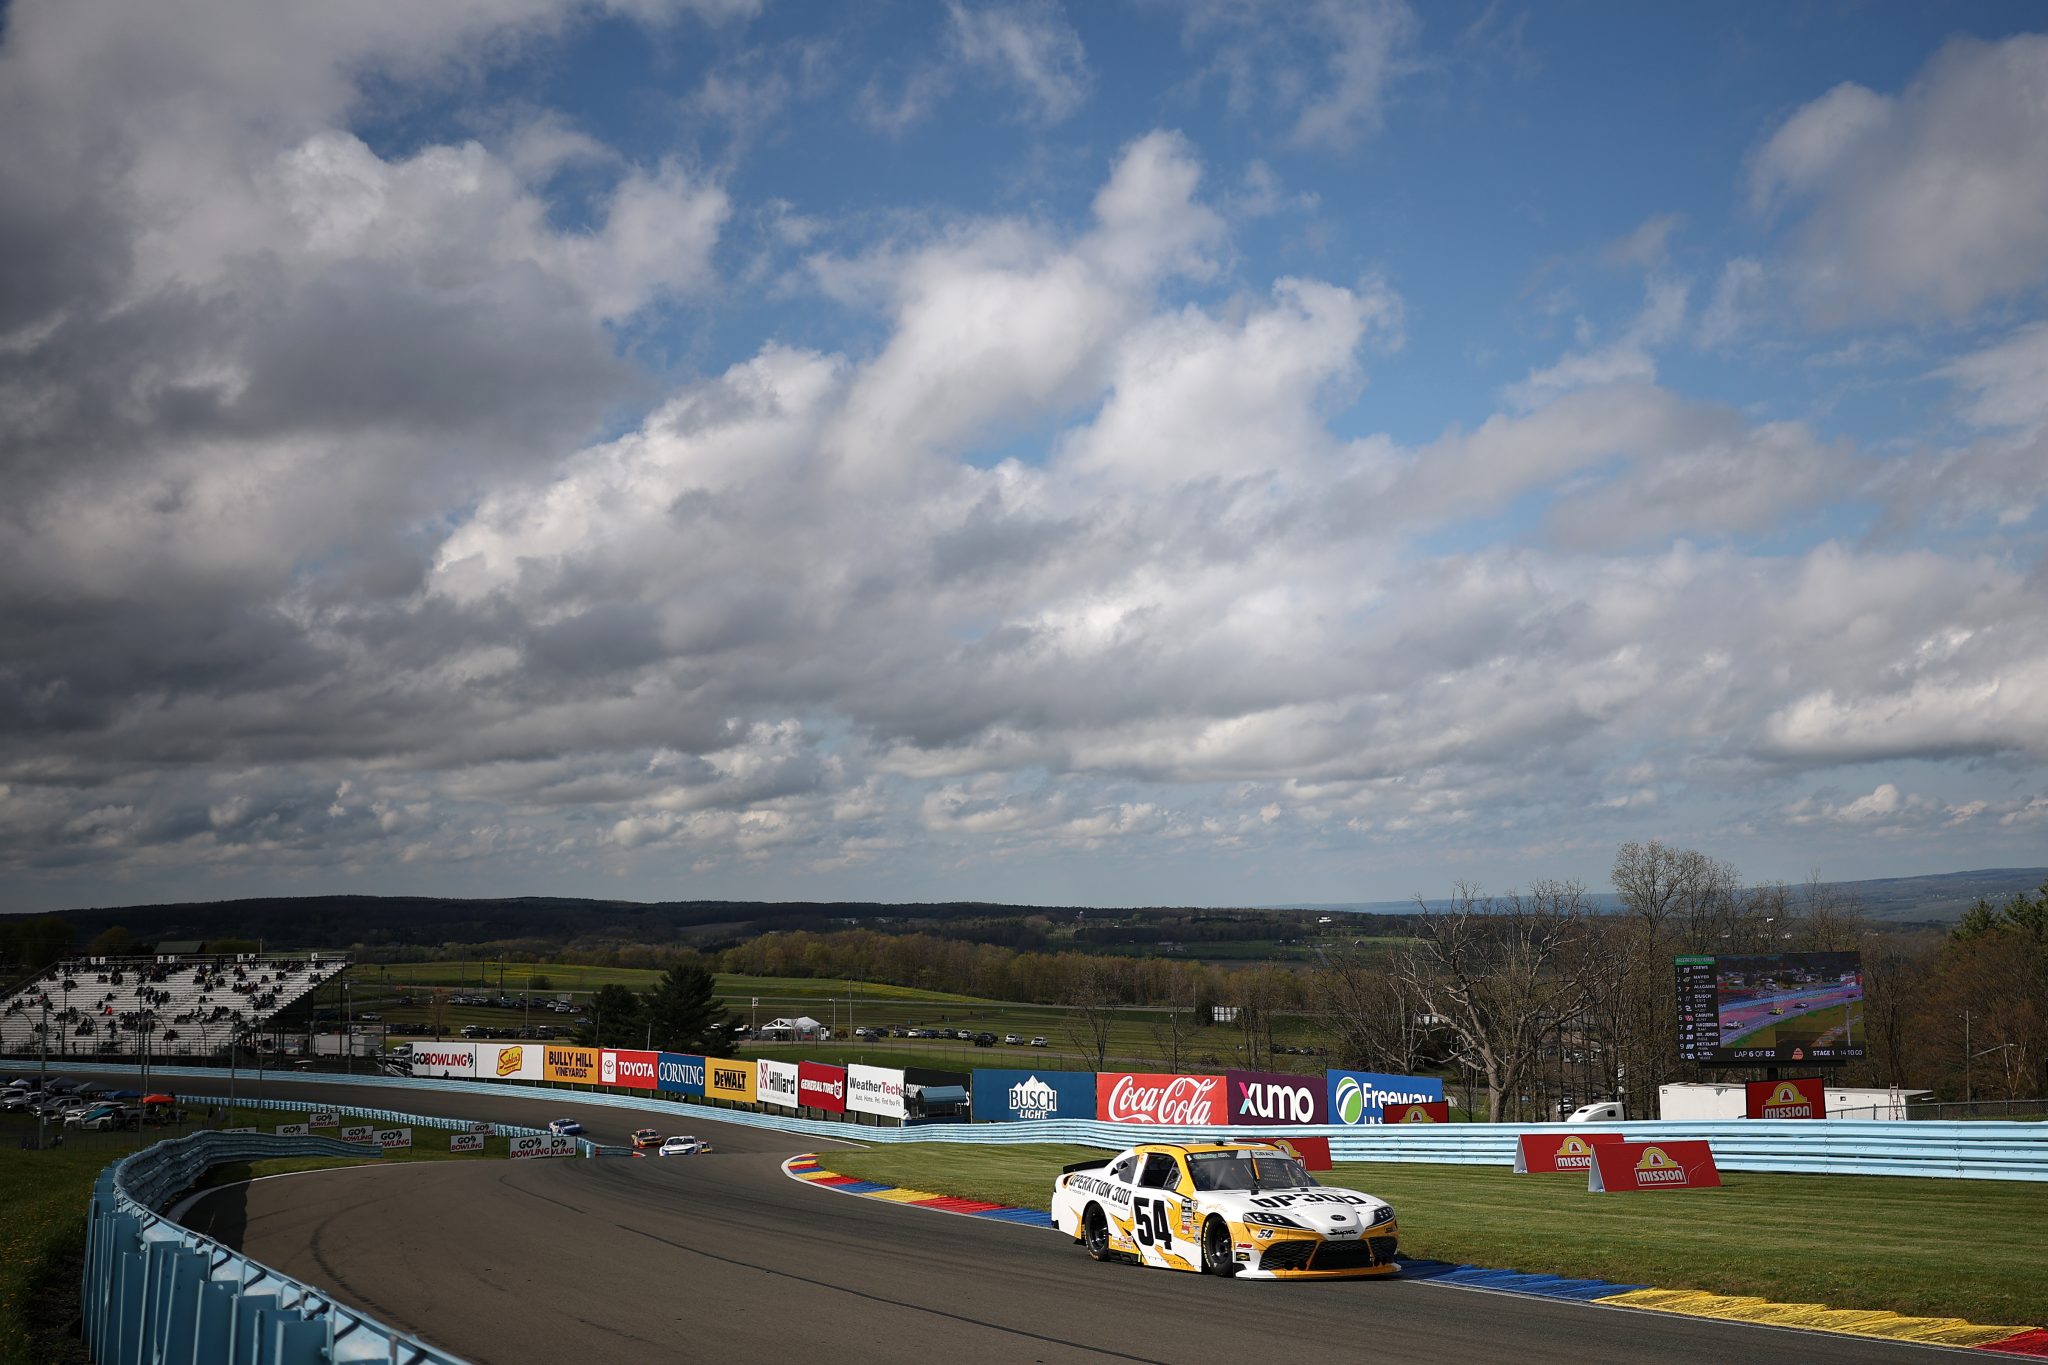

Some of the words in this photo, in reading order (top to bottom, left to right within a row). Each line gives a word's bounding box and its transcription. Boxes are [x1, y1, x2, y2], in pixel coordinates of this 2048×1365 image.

[413, 1052, 467, 1067] GOBOWLING
[548, 1051, 574, 1066] BULLY
[575, 1053, 594, 1068] HILL
[1734, 1050, 1747, 1058] LAP
[555, 1067, 588, 1079] VINEYARDS
[618, 1061, 655, 1078] TOYOTA
[658, 1061, 705, 1086] CORNING
[769, 1071, 796, 1095] Hilliard
[800, 1079, 823, 1093] GENERAL
[849, 1077, 901, 1096] WeatherTech
[1010, 1090, 1057, 1111] BUSCH
[1108, 1075, 1218, 1125] Coca-Cola
[282, 1126, 295, 1134] GO
[348, 1128, 360, 1136] GO
[475, 1123, 485, 1131] GO
[380, 1130, 397, 1140] GO
[458, 1135, 471, 1144] GO
[451, 1142, 482, 1151] BOWLING
[518, 1139, 535, 1149] GO
[511, 1148, 551, 1159] BOWLING
[1557, 1157, 1591, 1167] MISSIO
[1639, 1169, 1683, 1182] MISSION
[1069, 1174, 1114, 1199] OPERATION
[1112, 1186, 1132, 1206] 300
[1134, 1196, 1172, 1251] 54
[1257, 1228, 1274, 1240] 54
[1327, 1228, 1358, 1238] Supra
